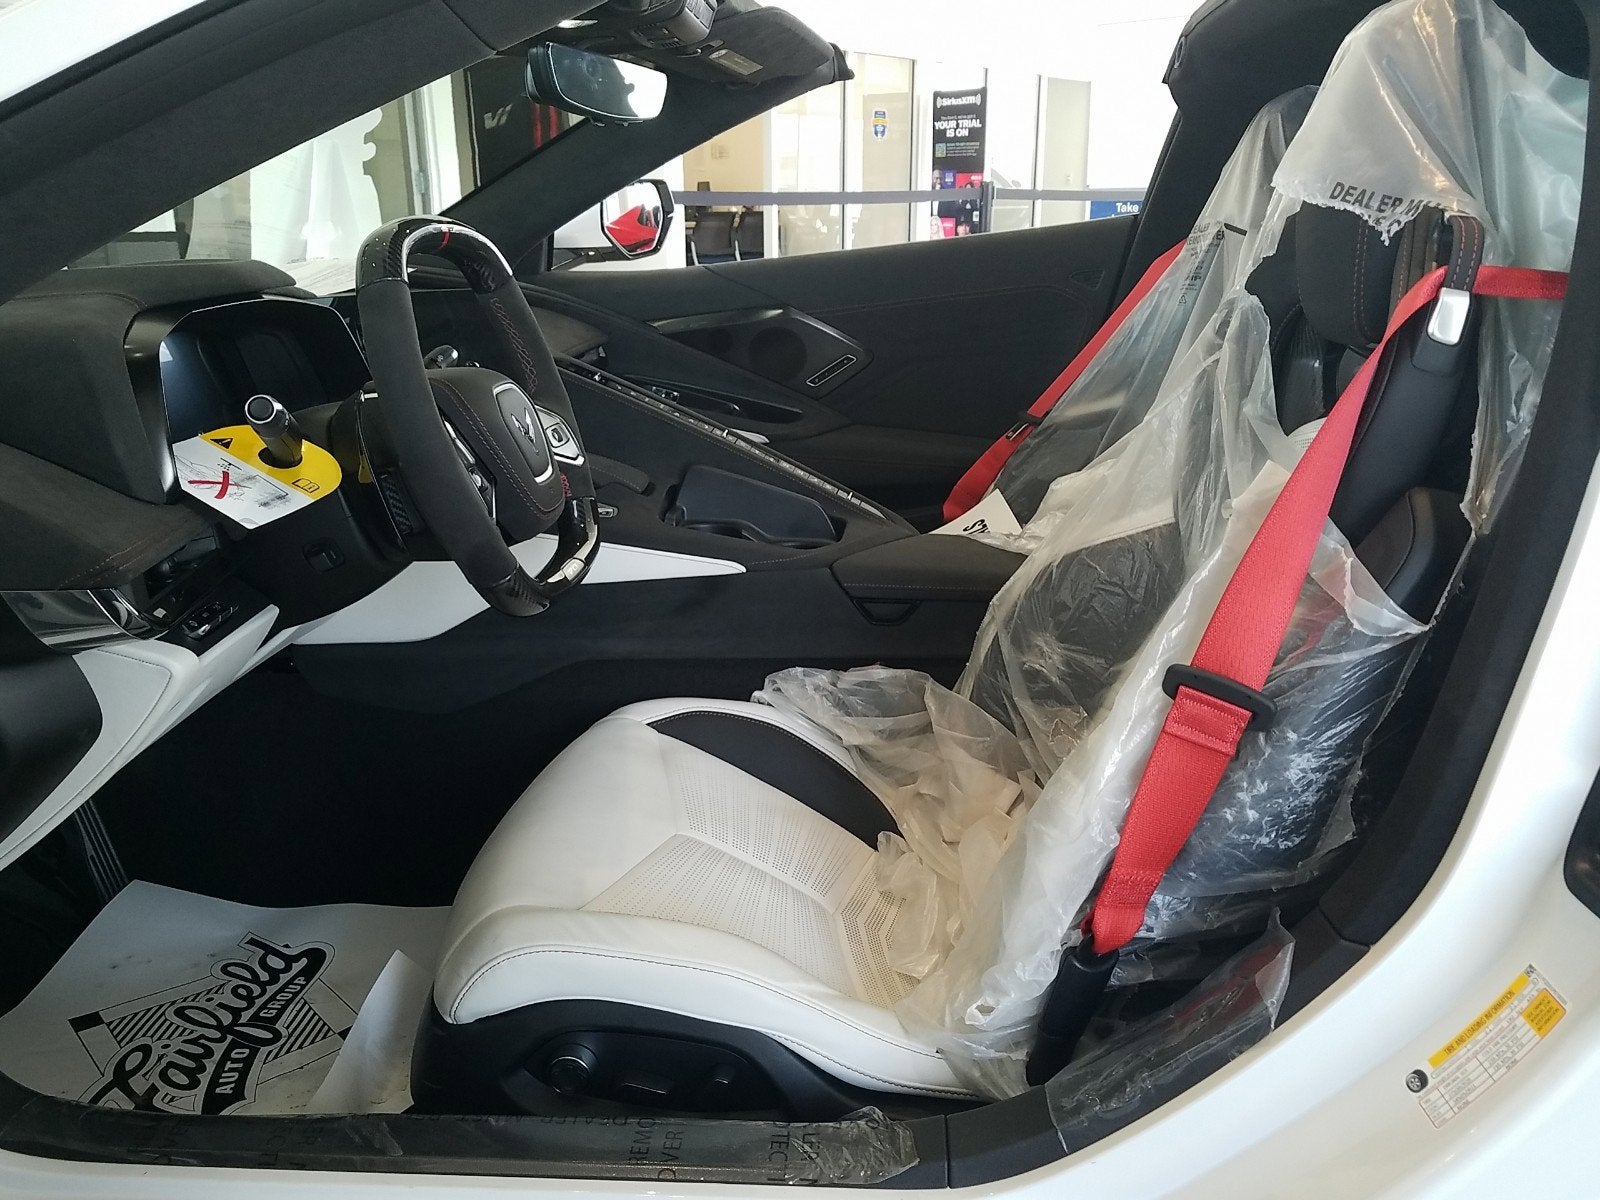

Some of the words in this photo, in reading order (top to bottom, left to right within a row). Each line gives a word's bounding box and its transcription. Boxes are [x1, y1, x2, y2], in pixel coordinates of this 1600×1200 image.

[934, 120, 957, 130] YOUR
[958, 118, 982, 128] TRIAL
[946, 129, 955, 137] IS
[955, 128, 969, 137] ON
[1115, 202, 1139, 213] Take
[1329, 181, 1404, 213] DEALER
[259, 976, 308, 1019] GROUP
[86, 936, 327, 1114] Fairfield
[214, 1047, 250, 1095] AUTO
